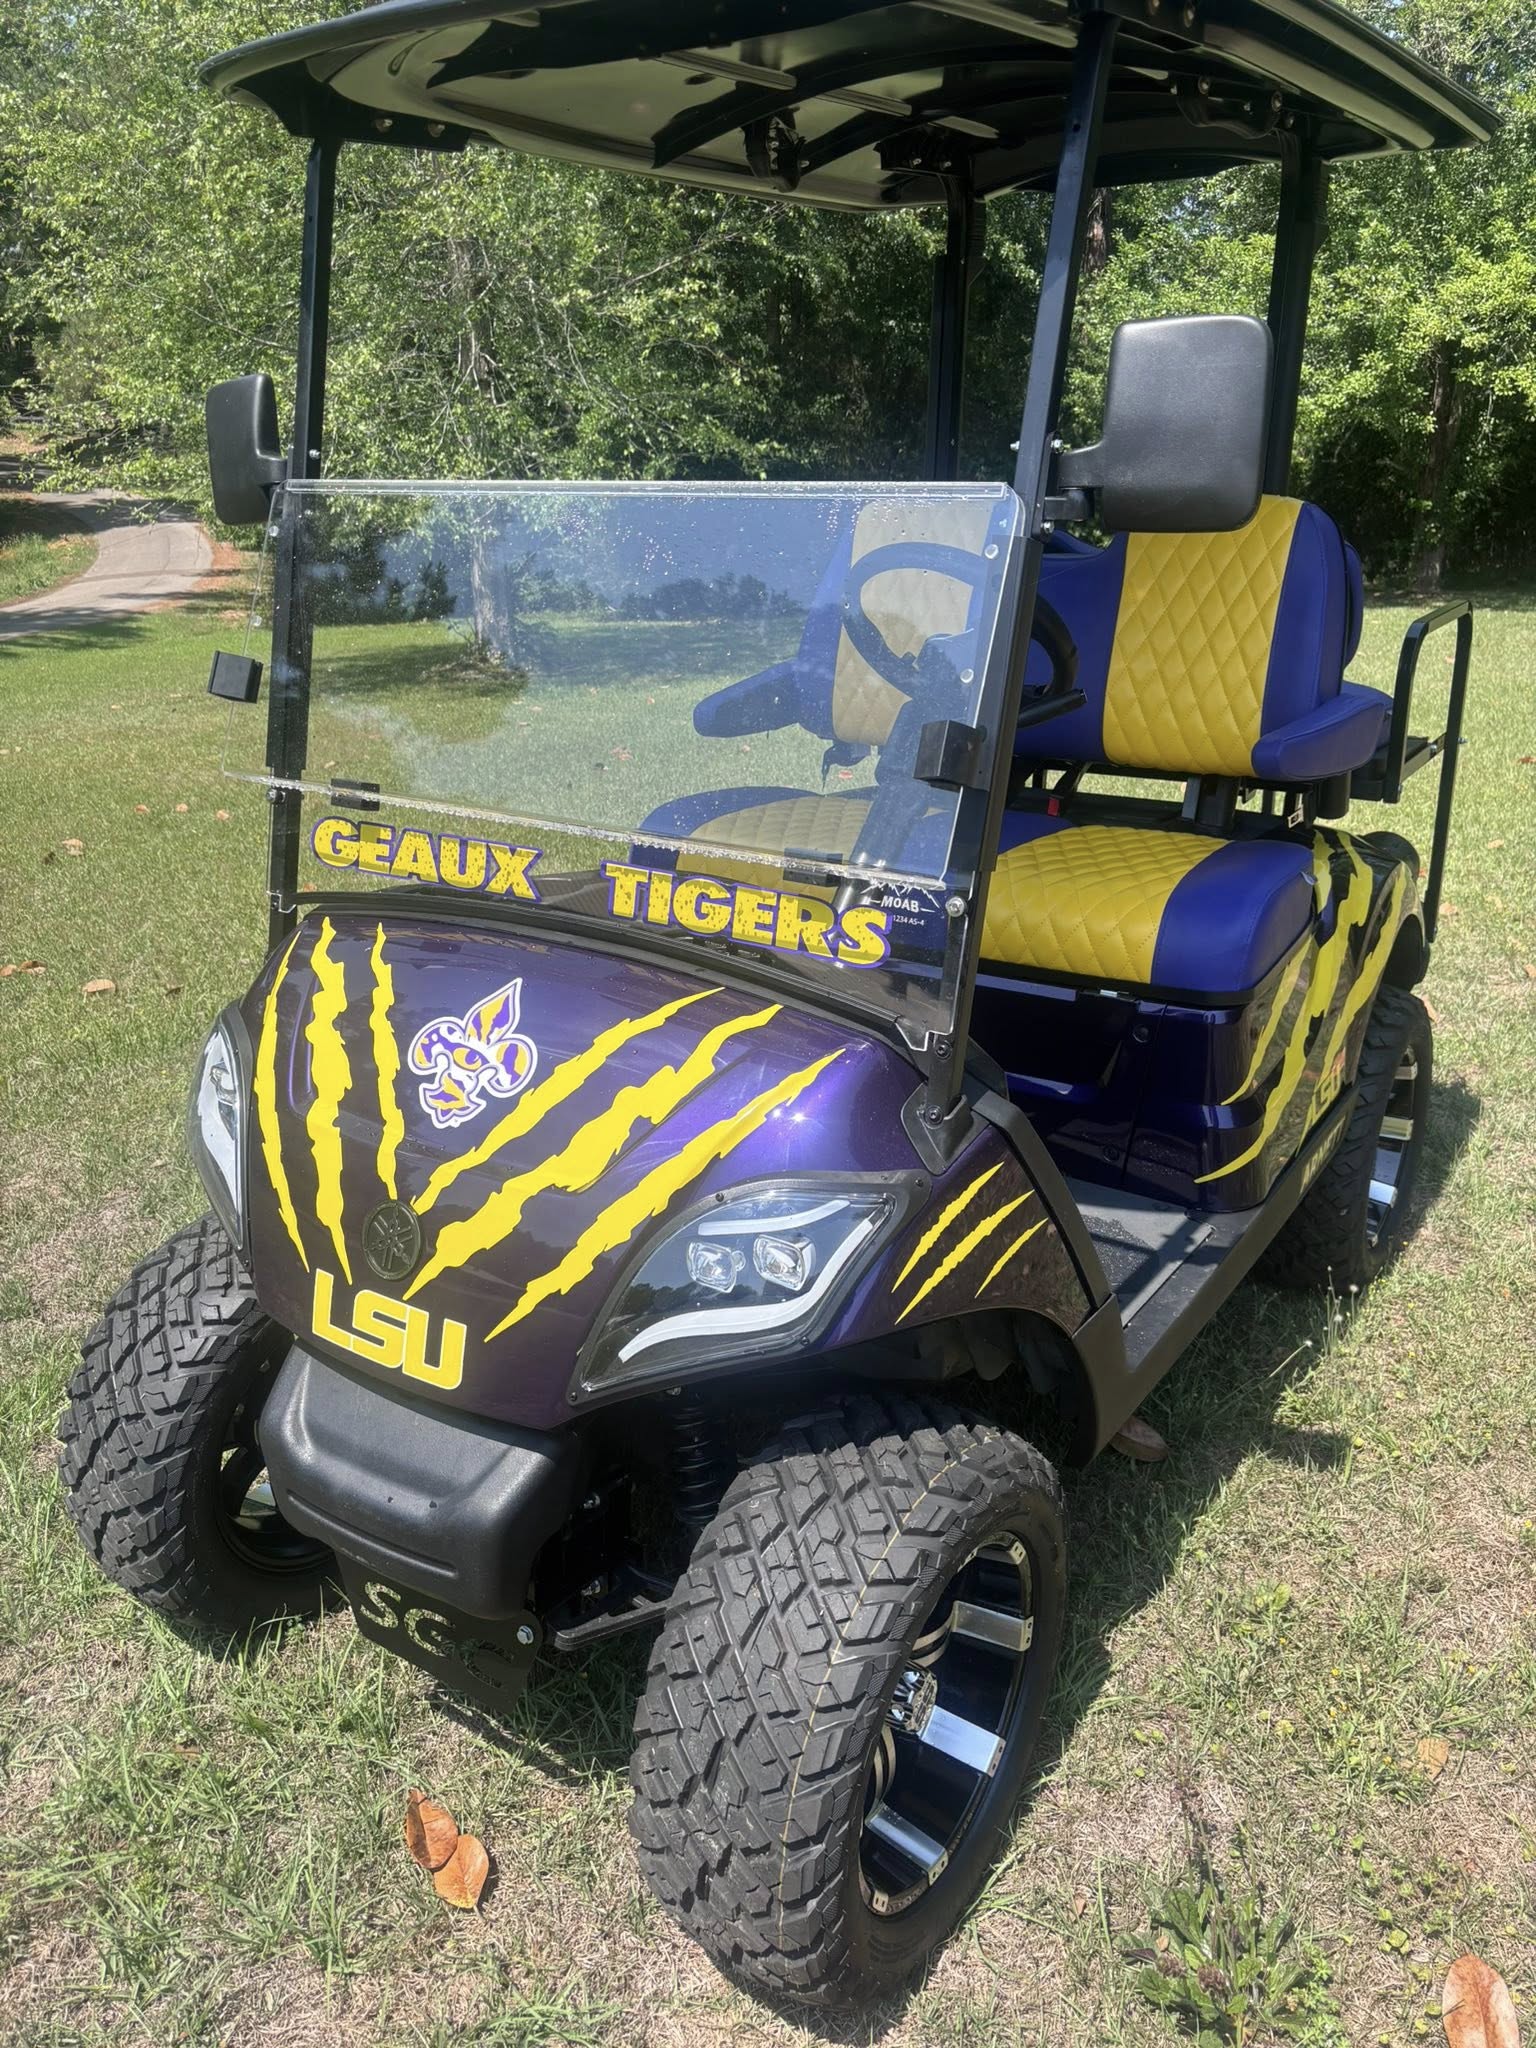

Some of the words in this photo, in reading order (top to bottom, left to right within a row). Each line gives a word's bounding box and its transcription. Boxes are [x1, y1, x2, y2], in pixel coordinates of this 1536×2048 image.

[312, 816, 543, 902] GEAUX
[601, 859, 893, 970] TIGERS
[880, 895, 920, 913] MOAB
[312, 1267, 468, 1390] LSU
